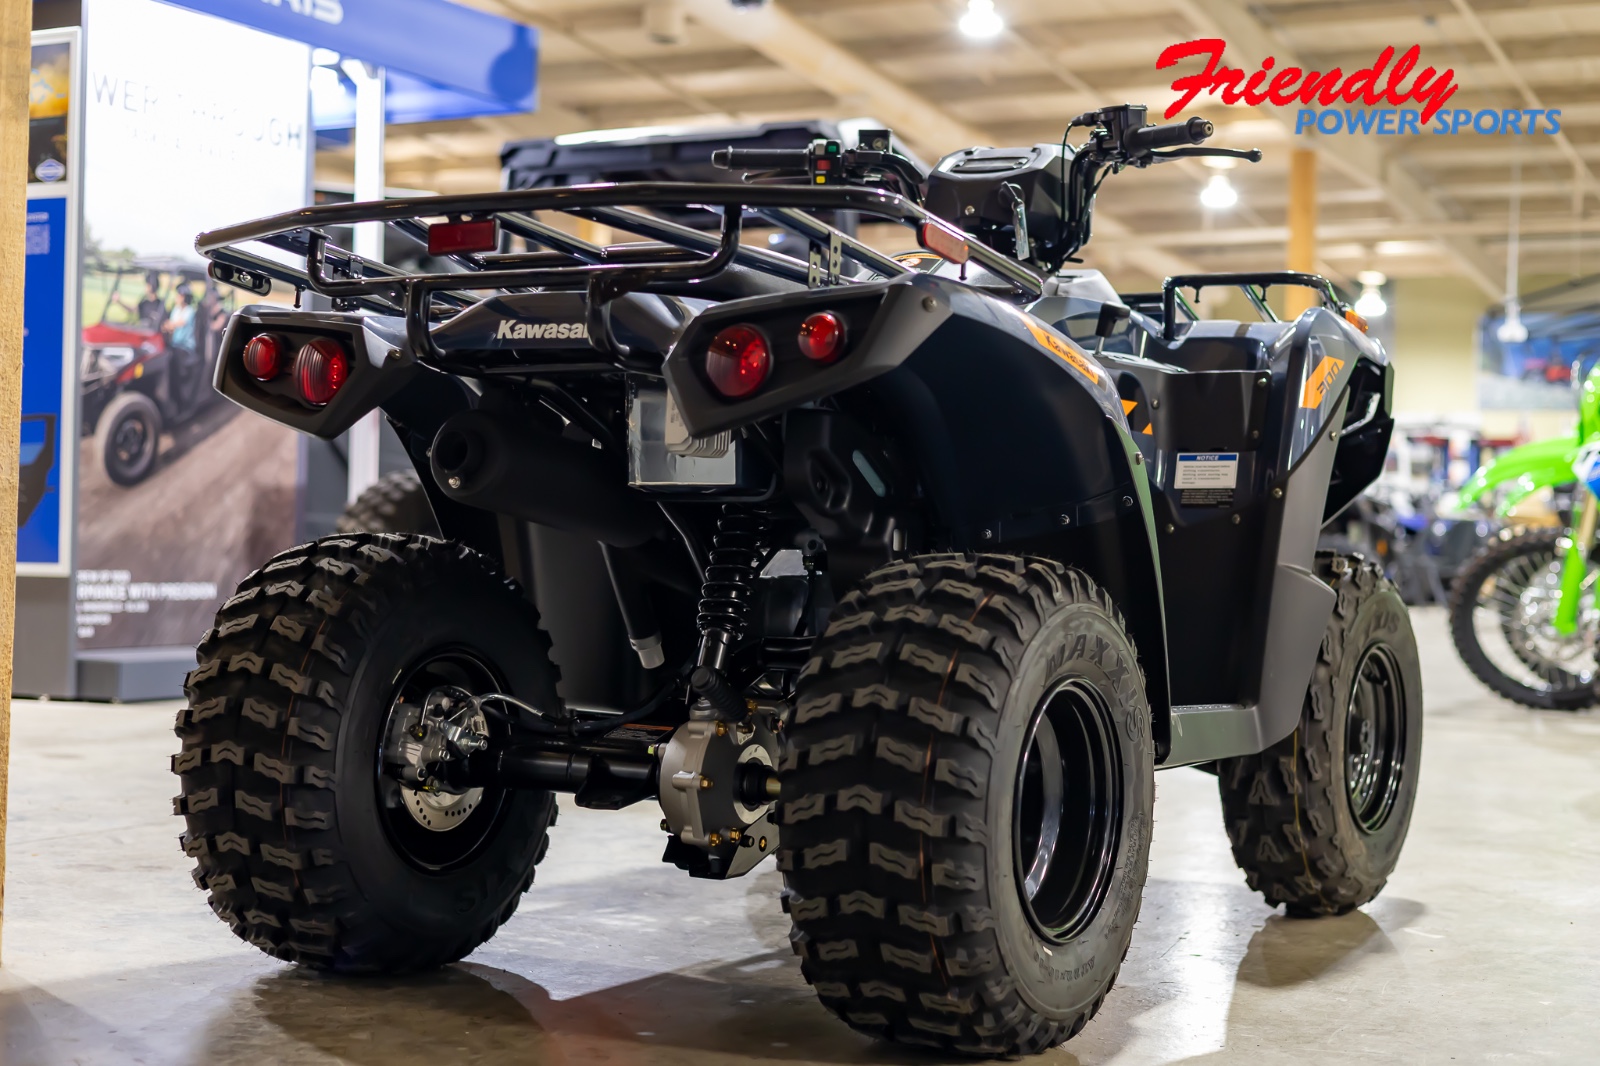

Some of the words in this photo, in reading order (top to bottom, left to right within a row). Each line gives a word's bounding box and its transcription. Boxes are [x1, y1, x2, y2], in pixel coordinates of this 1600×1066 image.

[497, 320, 589, 339] Kawasa
[1316, 361, 1341, 395] 300
[1044, 633, 1145, 742] MAXXIS
